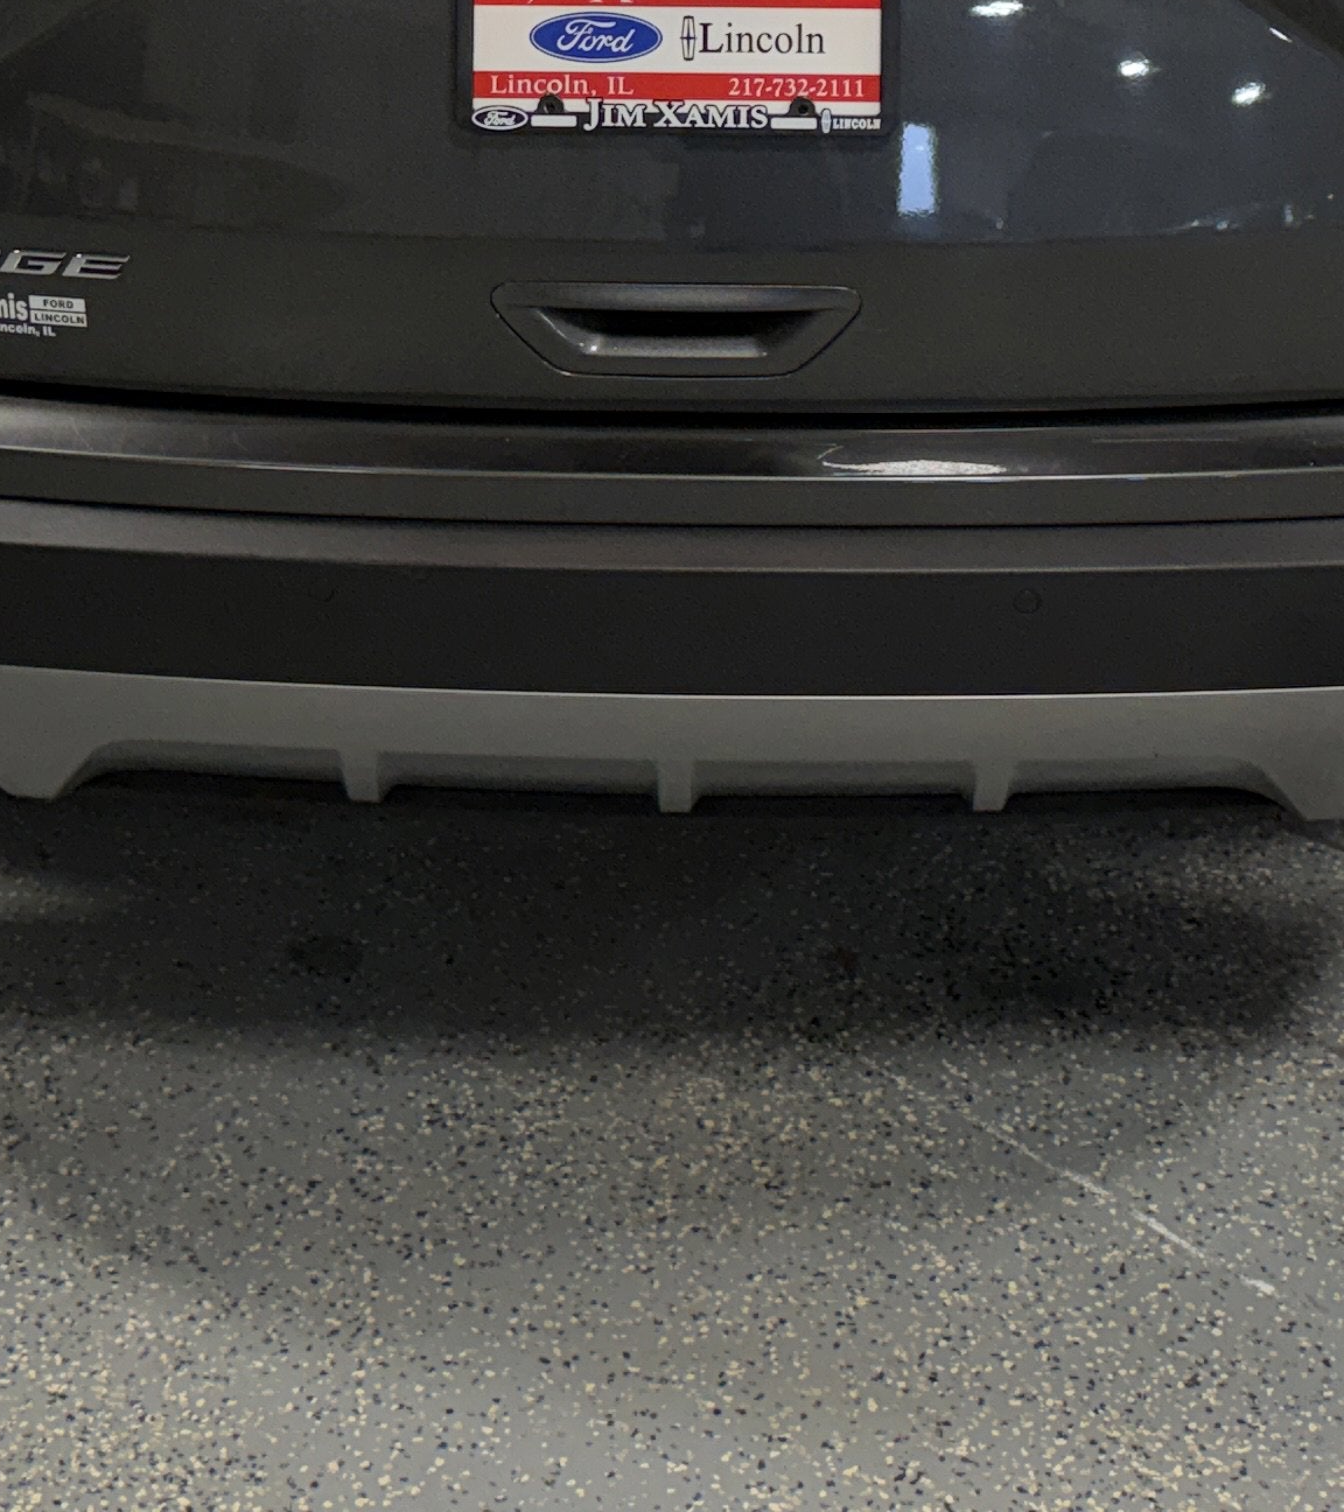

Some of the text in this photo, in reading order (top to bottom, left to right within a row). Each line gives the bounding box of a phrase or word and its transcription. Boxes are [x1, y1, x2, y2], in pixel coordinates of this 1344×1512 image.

[557, 19, 635, 53] Ford
[698, 22, 826, 55] Lincoln
[490, 75, 634, 97] Lincoln, IL
[728, 77, 864, 98] 217-732-2111
[484, 110, 516, 126] Ford
[583, 98, 768, 131] JIM XAMIS
[833, 119, 881, 130] LINCOLN
[42, 298, 74, 309] FORD
[34, 313, 84, 324] LINCOLN
[42, 326, 56, 336] IL
